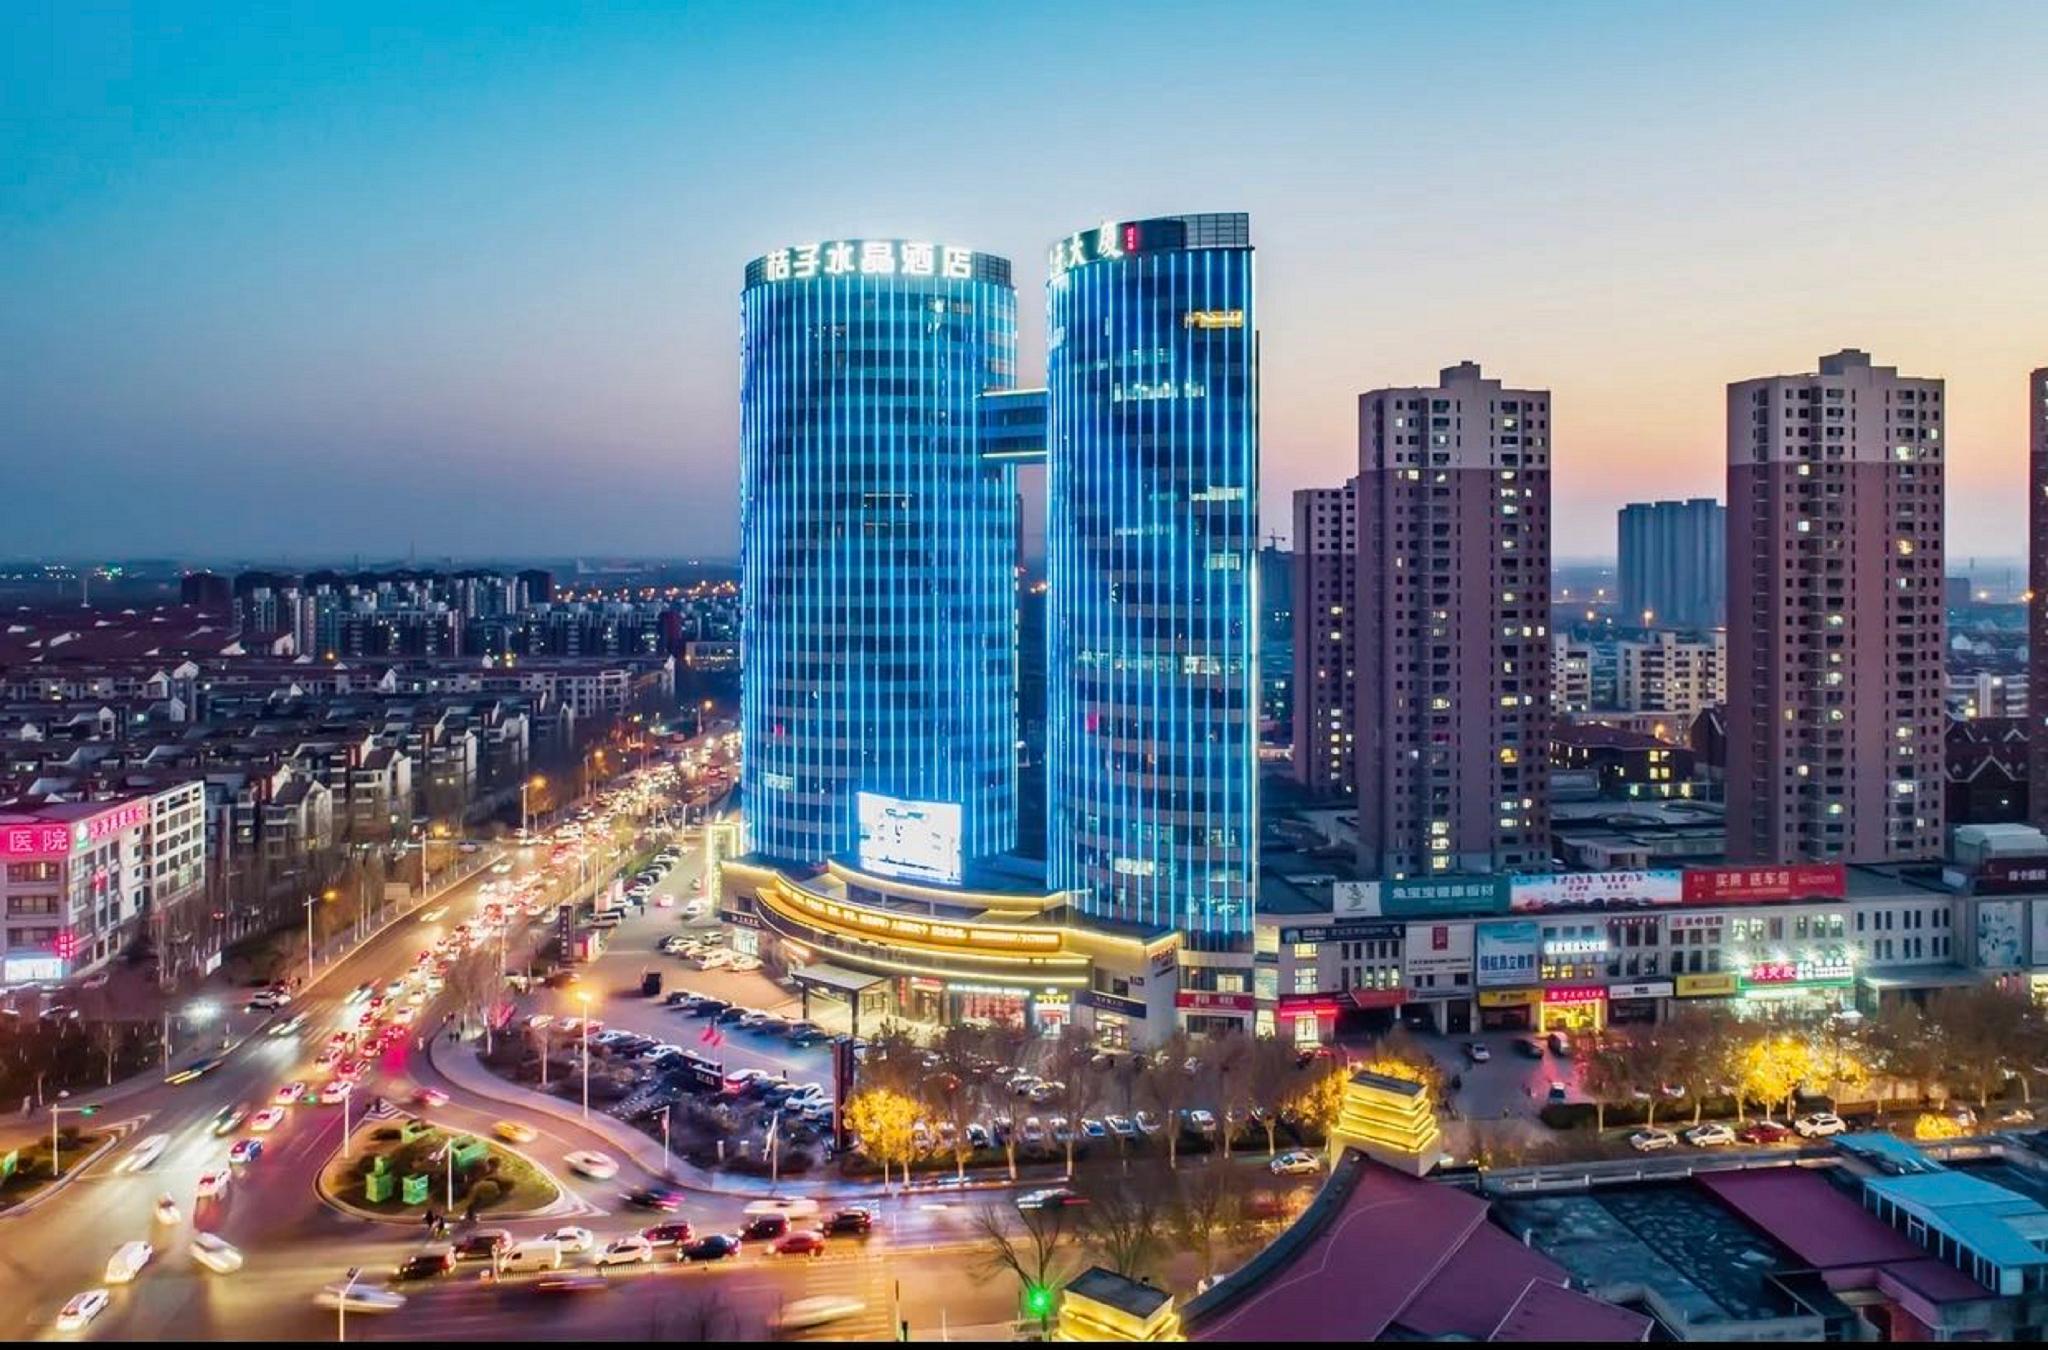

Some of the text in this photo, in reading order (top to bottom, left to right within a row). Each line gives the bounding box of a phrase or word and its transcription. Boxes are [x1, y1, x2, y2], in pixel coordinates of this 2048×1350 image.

[766, 240, 973, 281] 桔子水晶酒店
[8, 828, 69, 853] 医院
